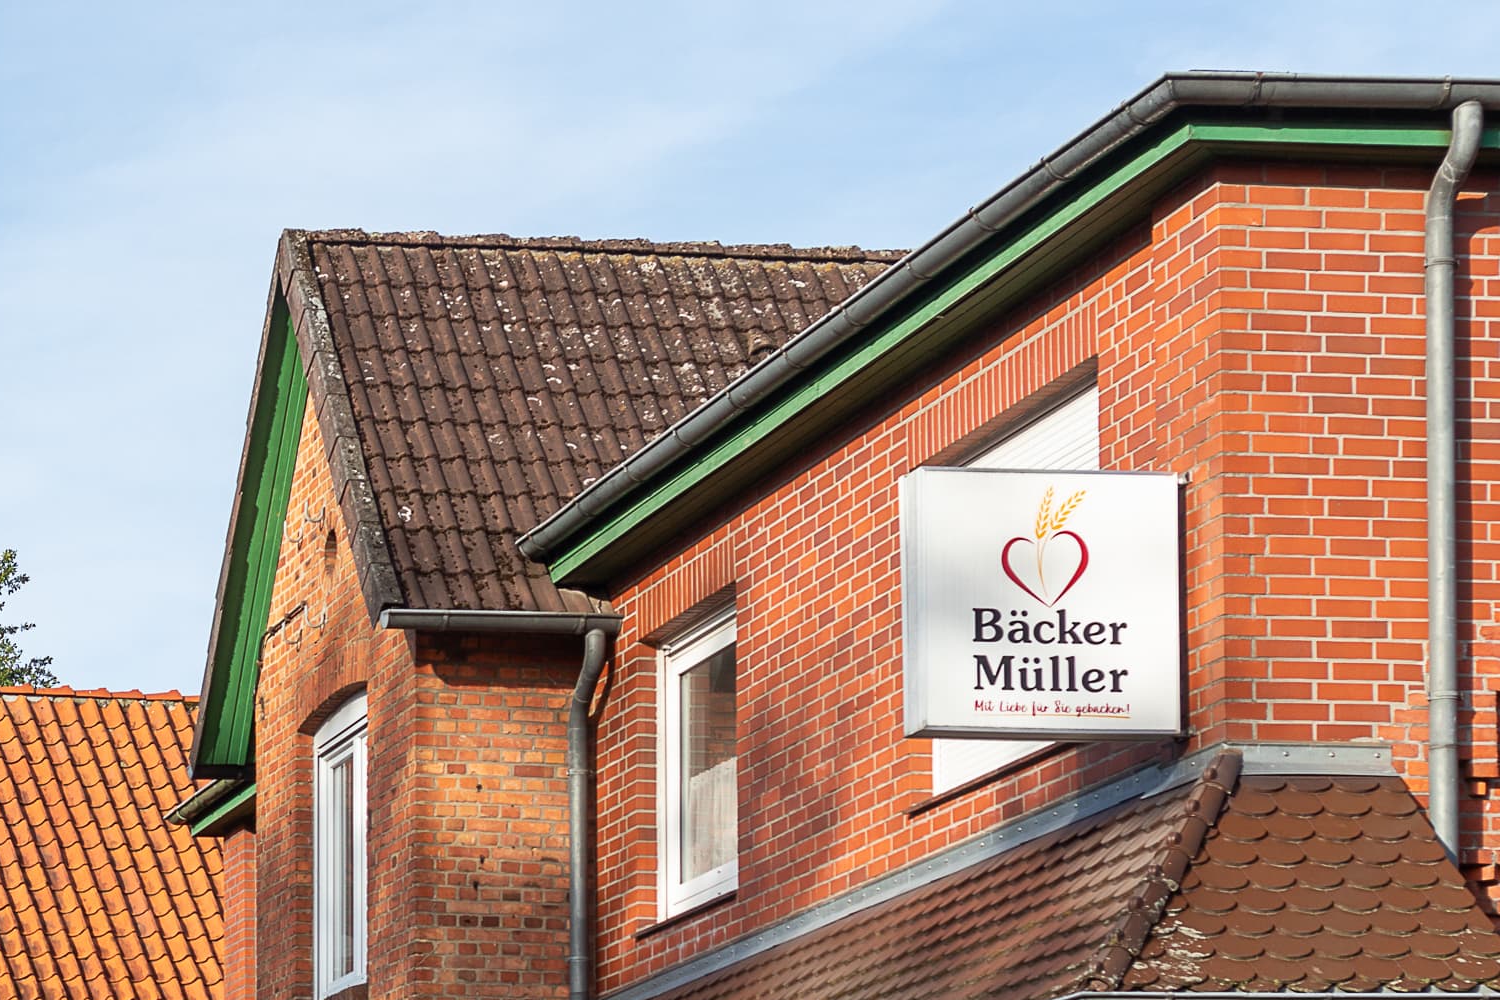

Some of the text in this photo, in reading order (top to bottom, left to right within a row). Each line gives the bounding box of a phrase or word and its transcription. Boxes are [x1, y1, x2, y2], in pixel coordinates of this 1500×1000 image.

[972, 607, 1128, 645] Bäcker
[973, 654, 1129, 693] Müller
[974, 700, 1131, 717] Mit Liebe für Sie gebacken!
